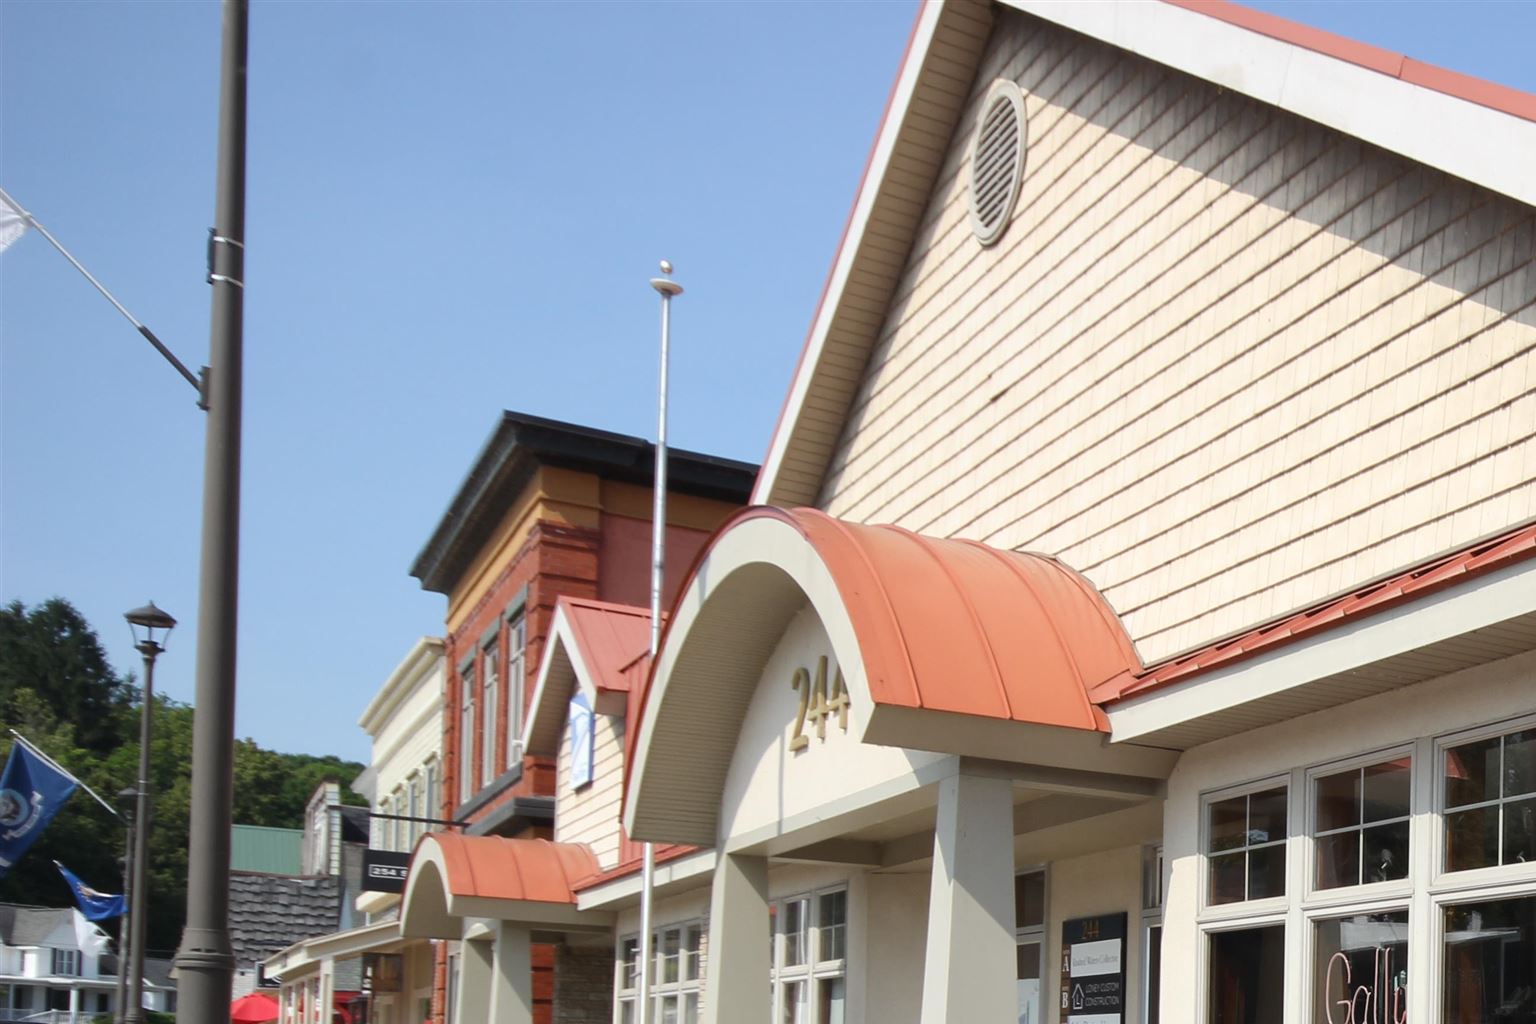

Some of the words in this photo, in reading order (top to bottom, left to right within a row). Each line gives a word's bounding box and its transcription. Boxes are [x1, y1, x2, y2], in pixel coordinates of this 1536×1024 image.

[790, 655, 850, 752] 244
[1081, 919, 1100, 939] 244
[1062, 955, 1070, 972] A
[1062, 992, 1069, 1008] B
